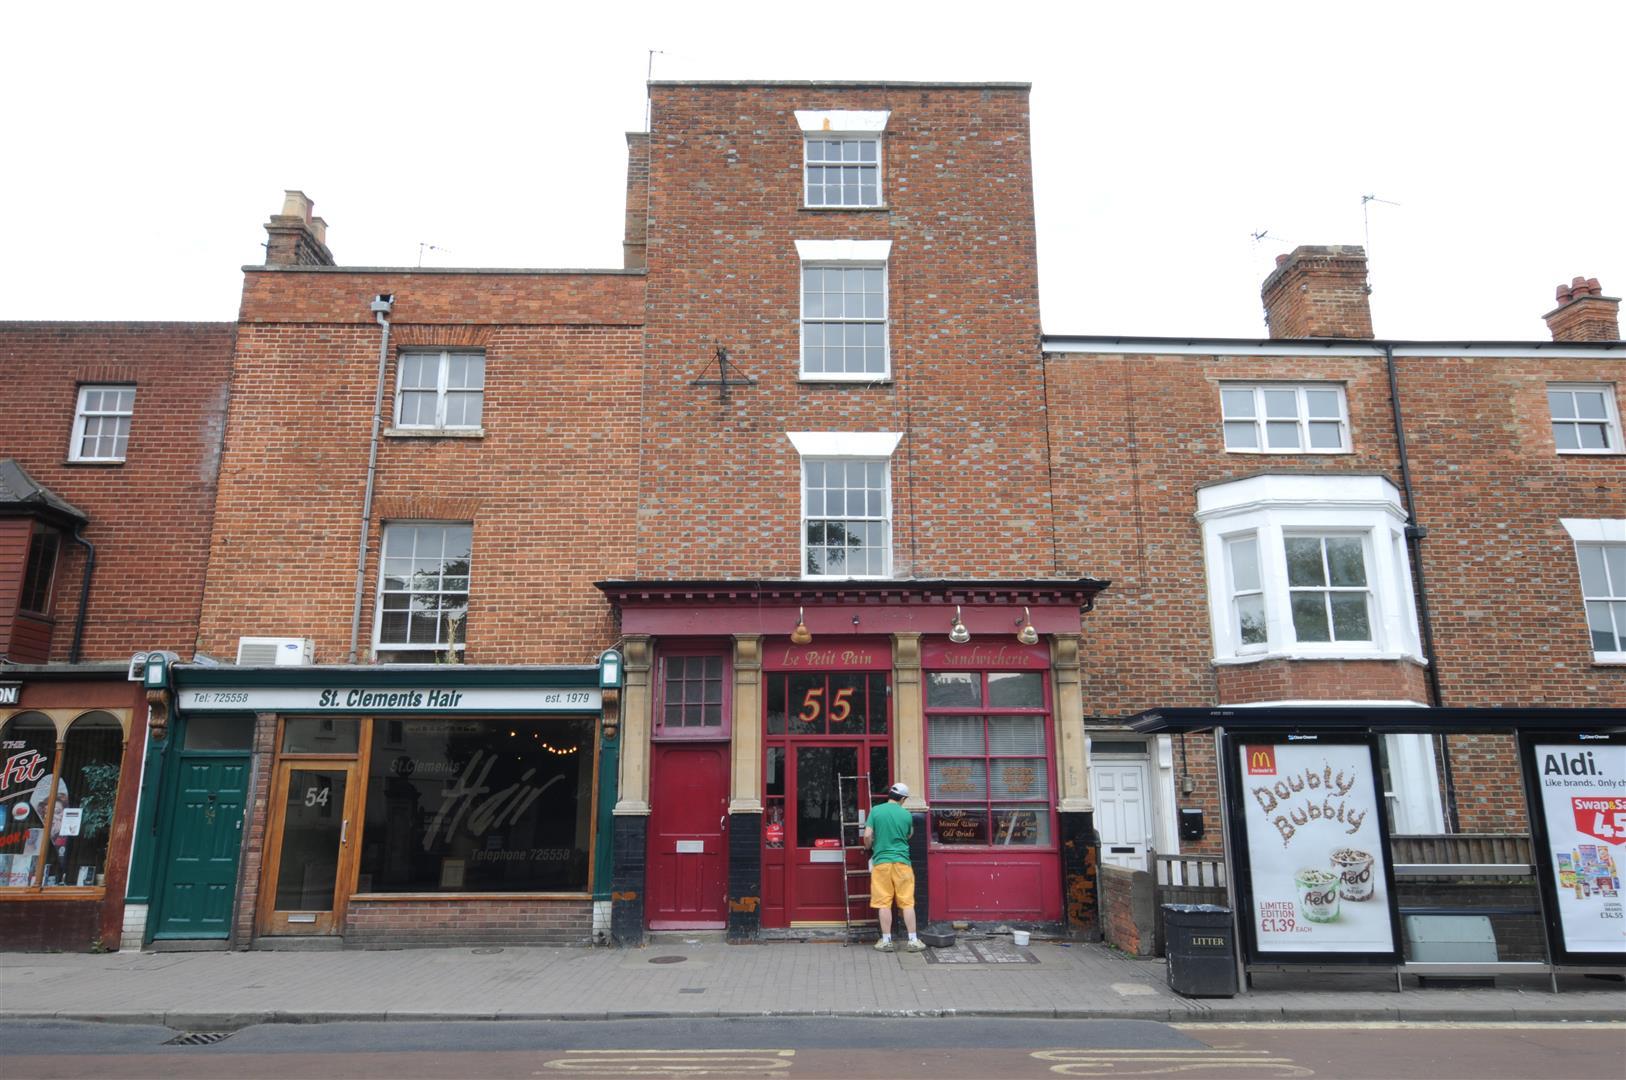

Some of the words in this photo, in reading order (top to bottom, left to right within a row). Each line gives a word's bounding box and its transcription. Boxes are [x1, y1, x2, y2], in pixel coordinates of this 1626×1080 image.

[781, 647, 799, 666] Le
[805, 650, 836, 665] Petit
[841, 650, 872, 665] Pain
[943, 646, 1030, 665] Sandwicherie
[194, 693, 211, 703] Tel:
[214, 693, 248, 703] 725558
[319, 689, 340, 707] St.
[346, 689, 422, 707] Clements
[427, 690, 462, 707] Hair
[545, 694, 561, 703] est.
[566, 693, 589, 703] 1979
[799, 688, 855, 721] 55
[3, 741, 26, 749] THE
[1545, 751, 1602, 775] Aldi.
[1252, 764, 1355, 815] Doubly
[1598, 780, 1616, 788] Only
[305, 787, 329, 806] 54
[422, 750, 565, 850] Hair
[1272, 799, 1367, 842] Bubbly
[471, 850, 526, 861] Telephone
[529, 849, 570, 860] 725558
[1261, 910, 1294, 918] EDITION
[1262, 919, 1295, 932] £1.39
[1193, 937, 1224, 945] LITTER
